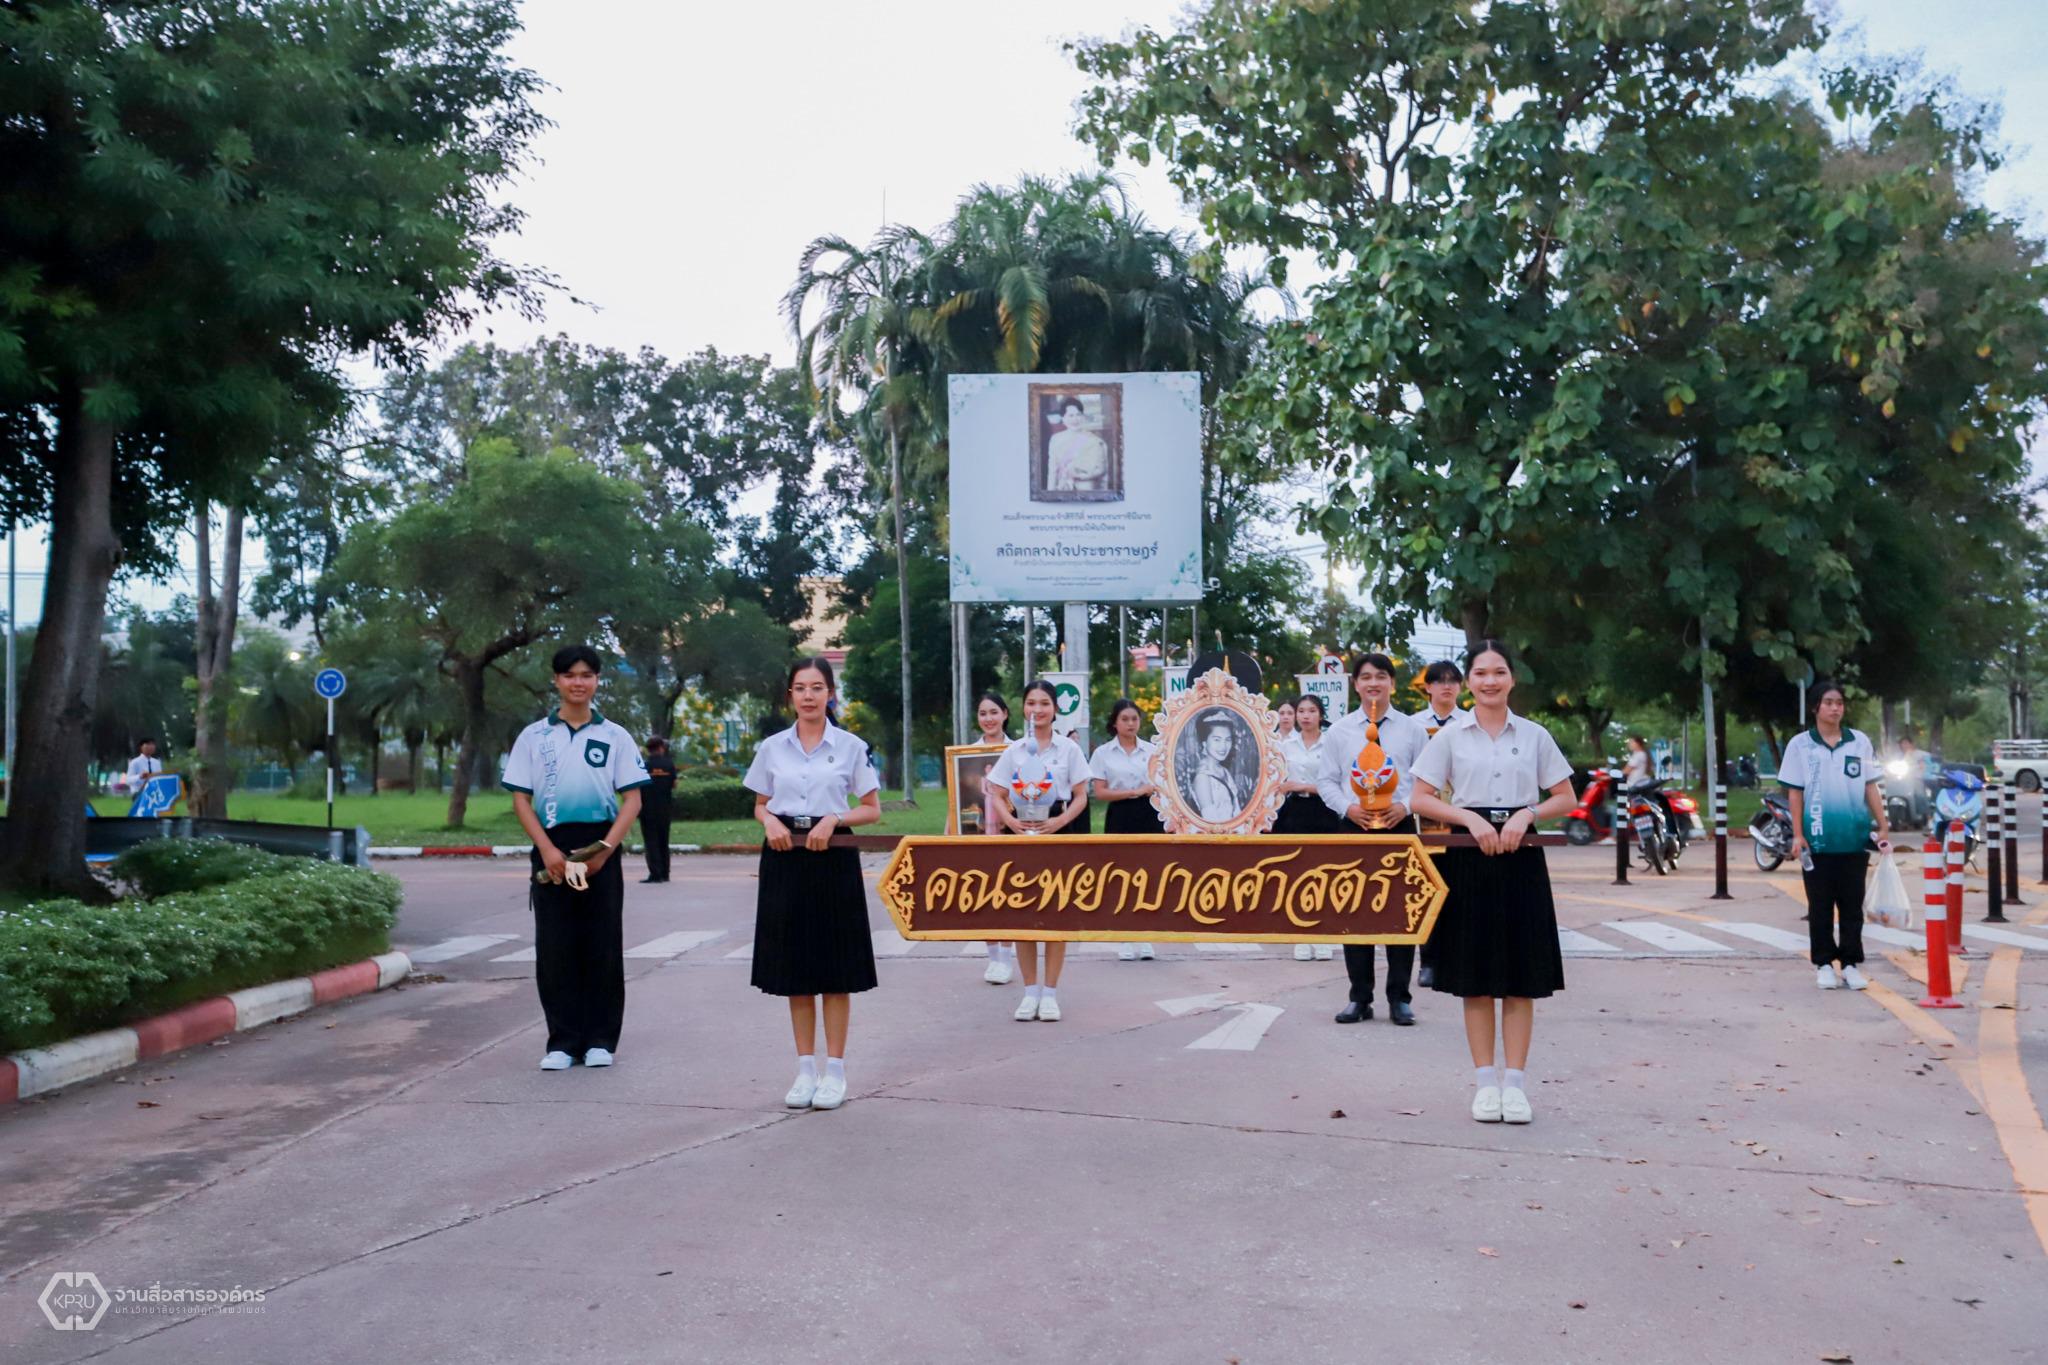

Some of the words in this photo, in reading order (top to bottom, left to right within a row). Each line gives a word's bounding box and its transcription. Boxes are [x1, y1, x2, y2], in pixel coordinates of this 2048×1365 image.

[996, 541, 1159, 559] สถิตกลางใจประชาราษฎร์
[1306, 681, 1343, 692] พยาบาล
[1810, 805, 1824, 836] SMO
[925, 847, 1409, 928] คณะพยาบาลศาสตร์
